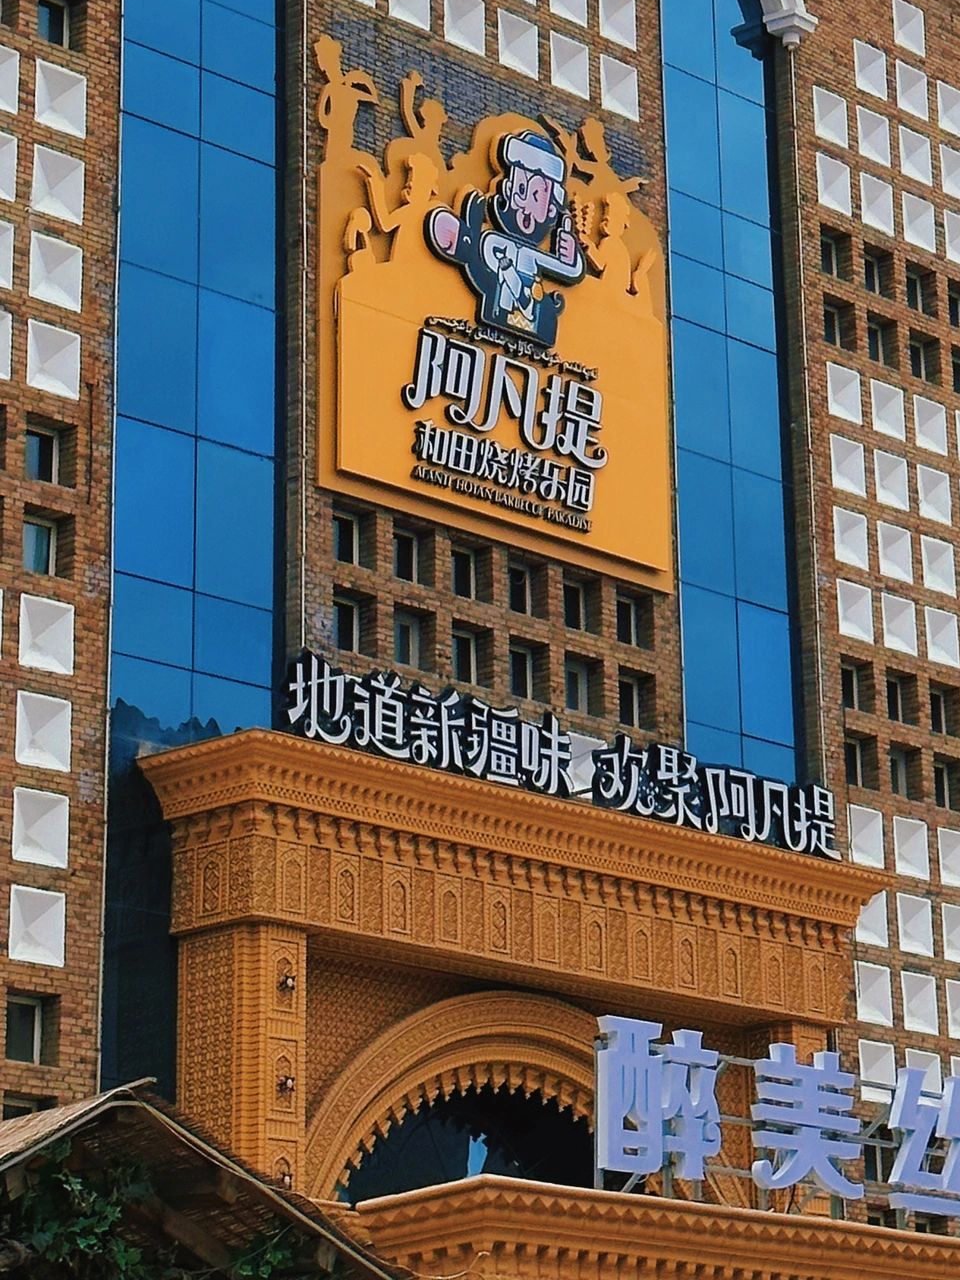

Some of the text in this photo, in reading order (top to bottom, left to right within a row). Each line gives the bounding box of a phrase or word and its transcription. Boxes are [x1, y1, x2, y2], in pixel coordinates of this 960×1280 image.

[404, 328, 609, 468] 阿凡提
[418, 420, 596, 512] 和田烧烤乐园
[456, 479, 495, 500] HOTAN
[495, 489, 544, 516] BARBECUE
[547, 506, 592, 531] PARADISE
[288, 656, 842, 860] 地道新疆味 欢聚阿凡提
